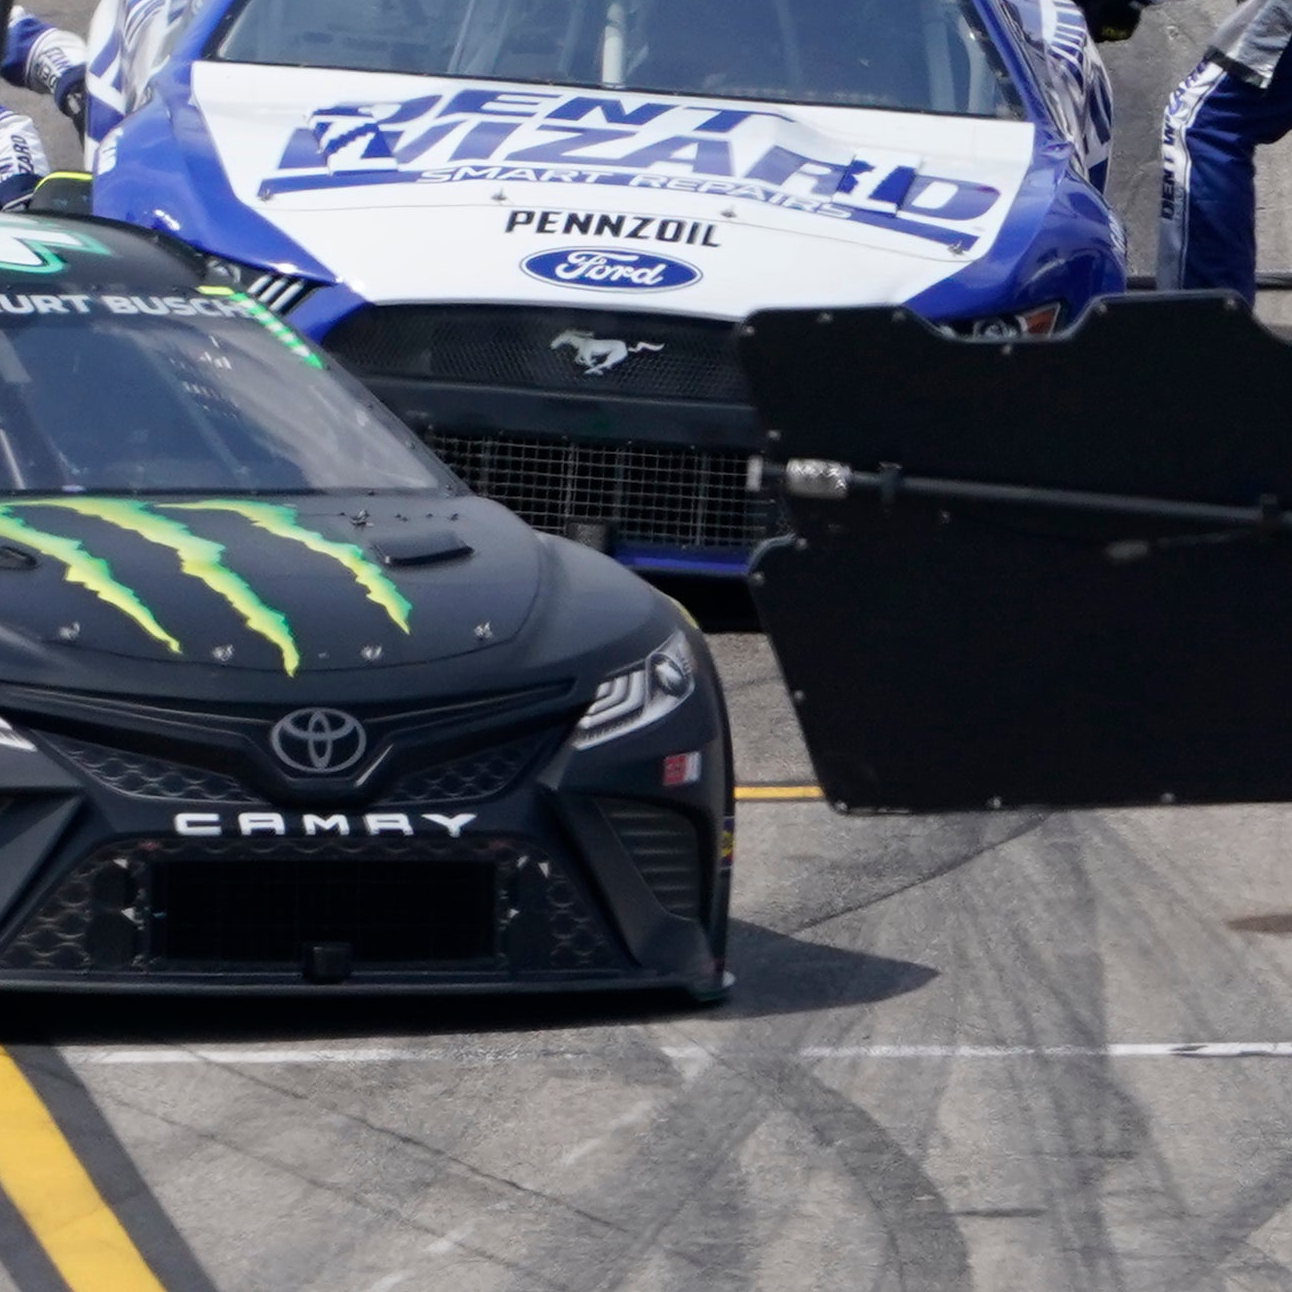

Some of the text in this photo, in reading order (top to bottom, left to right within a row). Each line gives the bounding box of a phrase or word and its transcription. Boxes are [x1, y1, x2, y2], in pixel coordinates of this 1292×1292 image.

[348, 88, 796, 133] DENT
[277, 122, 1001, 222] WIZARD
[418, 163, 853, 219] SMART REPAIRS
[507, 210, 722, 249] PENNZOIL
[555, 249, 666, 288] Ford
[105, 296, 256, 319] BUSCH
[174, 812, 477, 839] CAMRY
